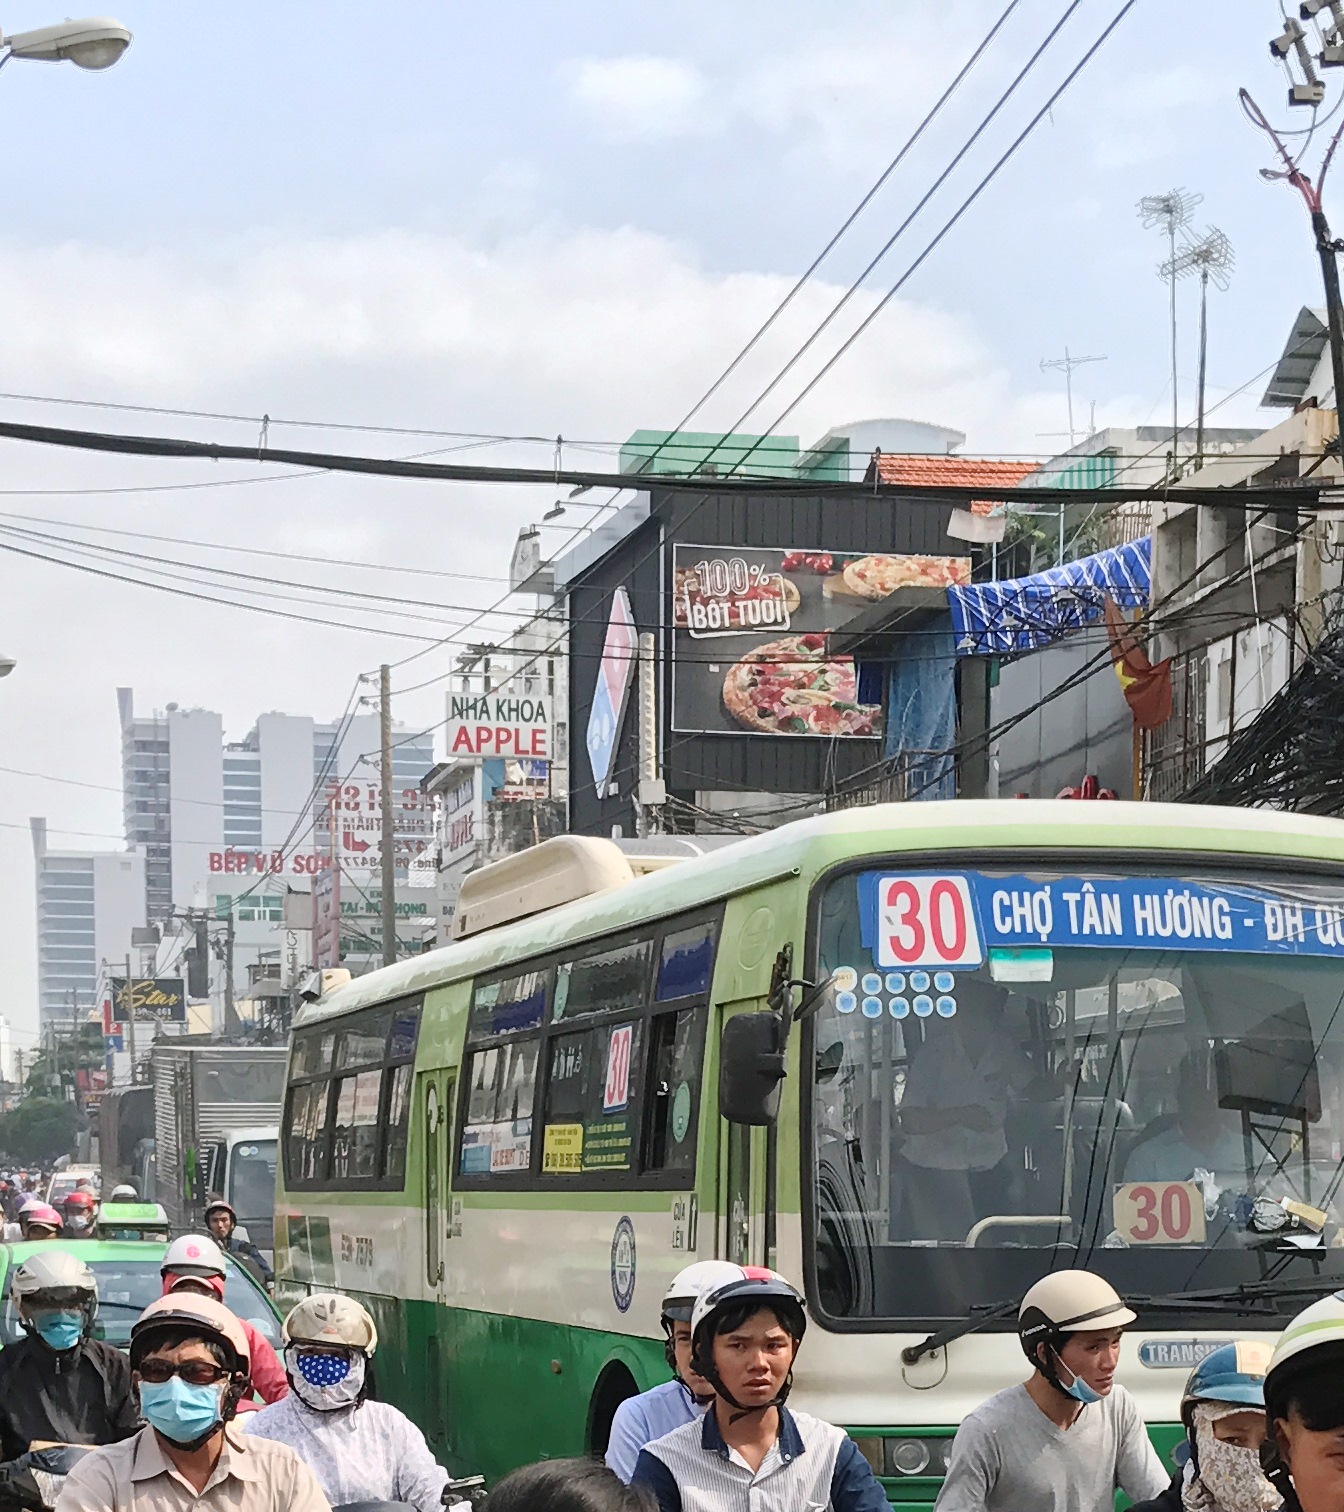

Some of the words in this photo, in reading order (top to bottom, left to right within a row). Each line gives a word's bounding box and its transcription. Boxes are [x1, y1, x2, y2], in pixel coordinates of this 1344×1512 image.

[694, 557, 769, 598] 100%
[451, 696, 491, 721] NHA
[496, 698, 547, 723] KHOA
[452, 725, 547, 755] APPLE
[887, 879, 967, 962] 30
[992, 885, 1053, 942] CHỢ
[1062, 882, 1123, 936] TÂN
[1133, 889, 1233, 939] HƯƠNG
[1264, 902, 1305, 942] ĐH
[607, 1030, 630, 1105] 30
[1129, 1184, 1191, 1240] 30
